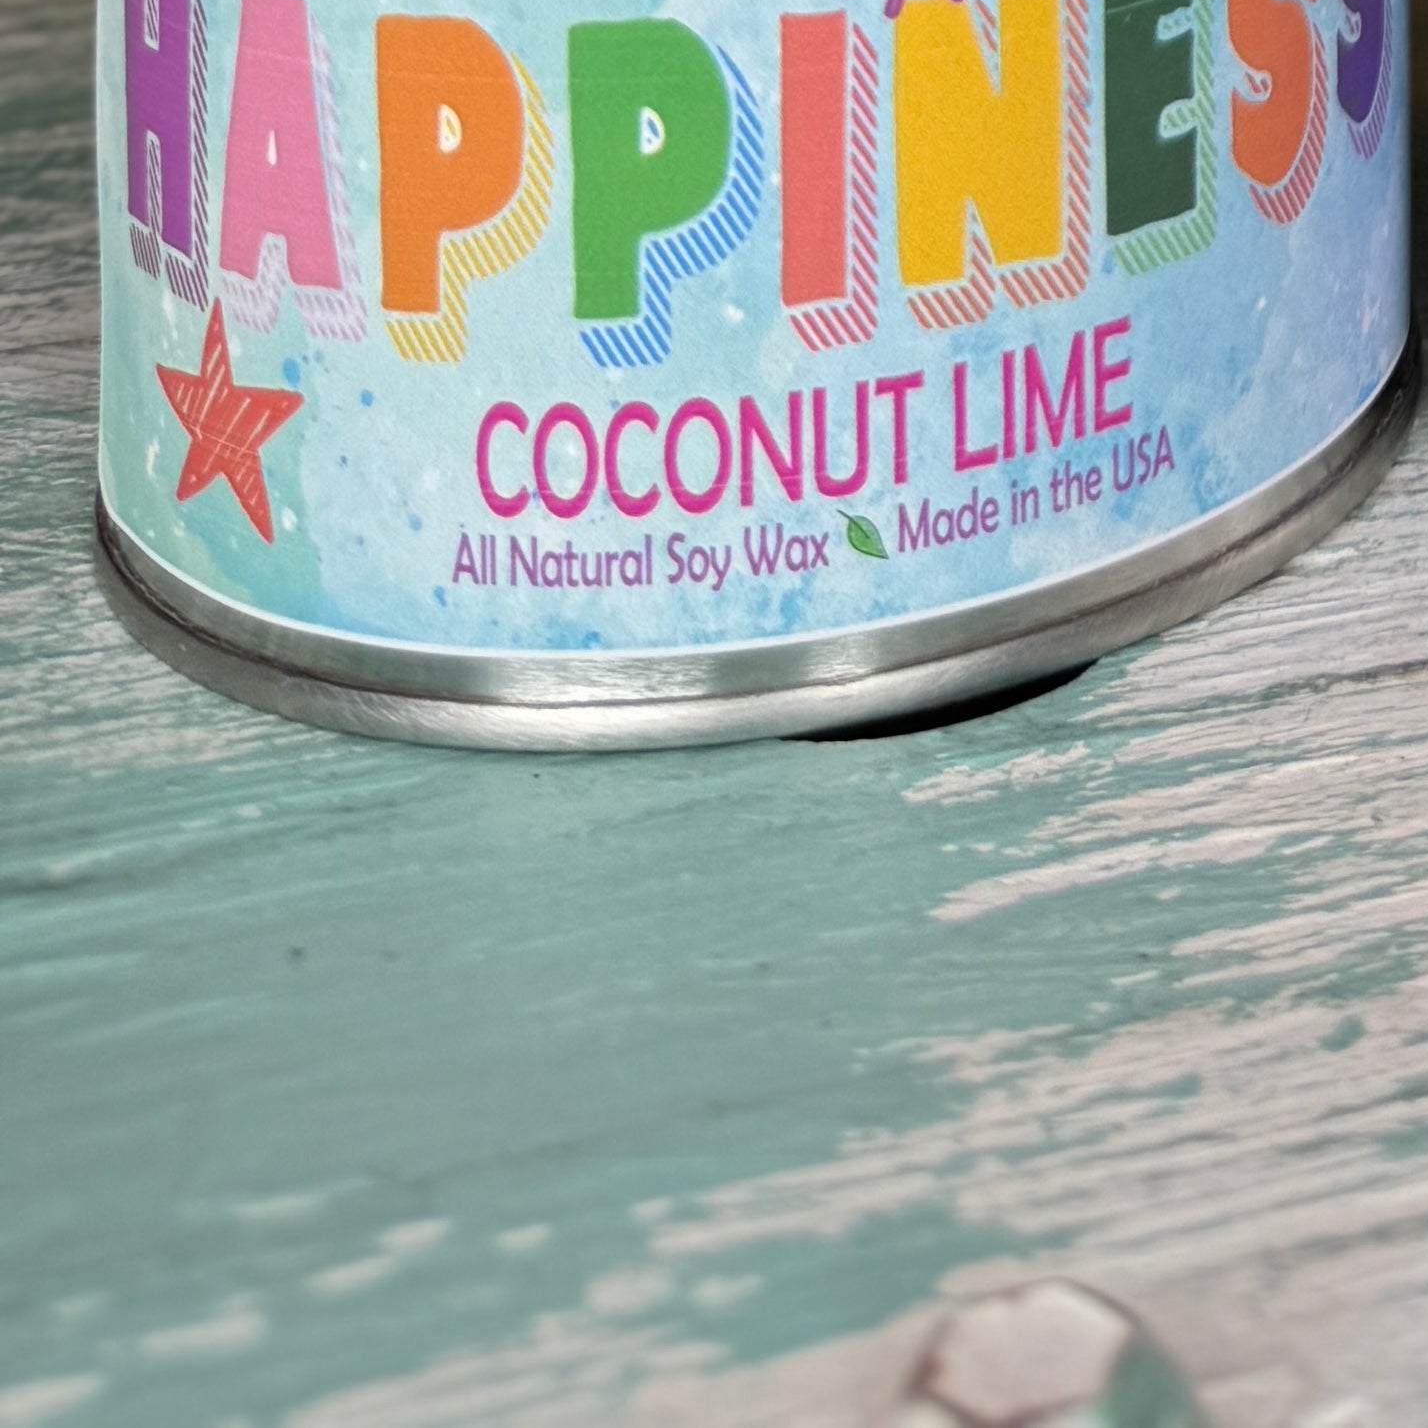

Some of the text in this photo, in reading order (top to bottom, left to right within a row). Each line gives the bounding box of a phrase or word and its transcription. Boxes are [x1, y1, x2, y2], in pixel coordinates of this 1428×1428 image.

[452, 424, 1176, 591] All Natural Soy Wax Made in the USA
[475, 314, 1133, 519] COCONUT LIME
